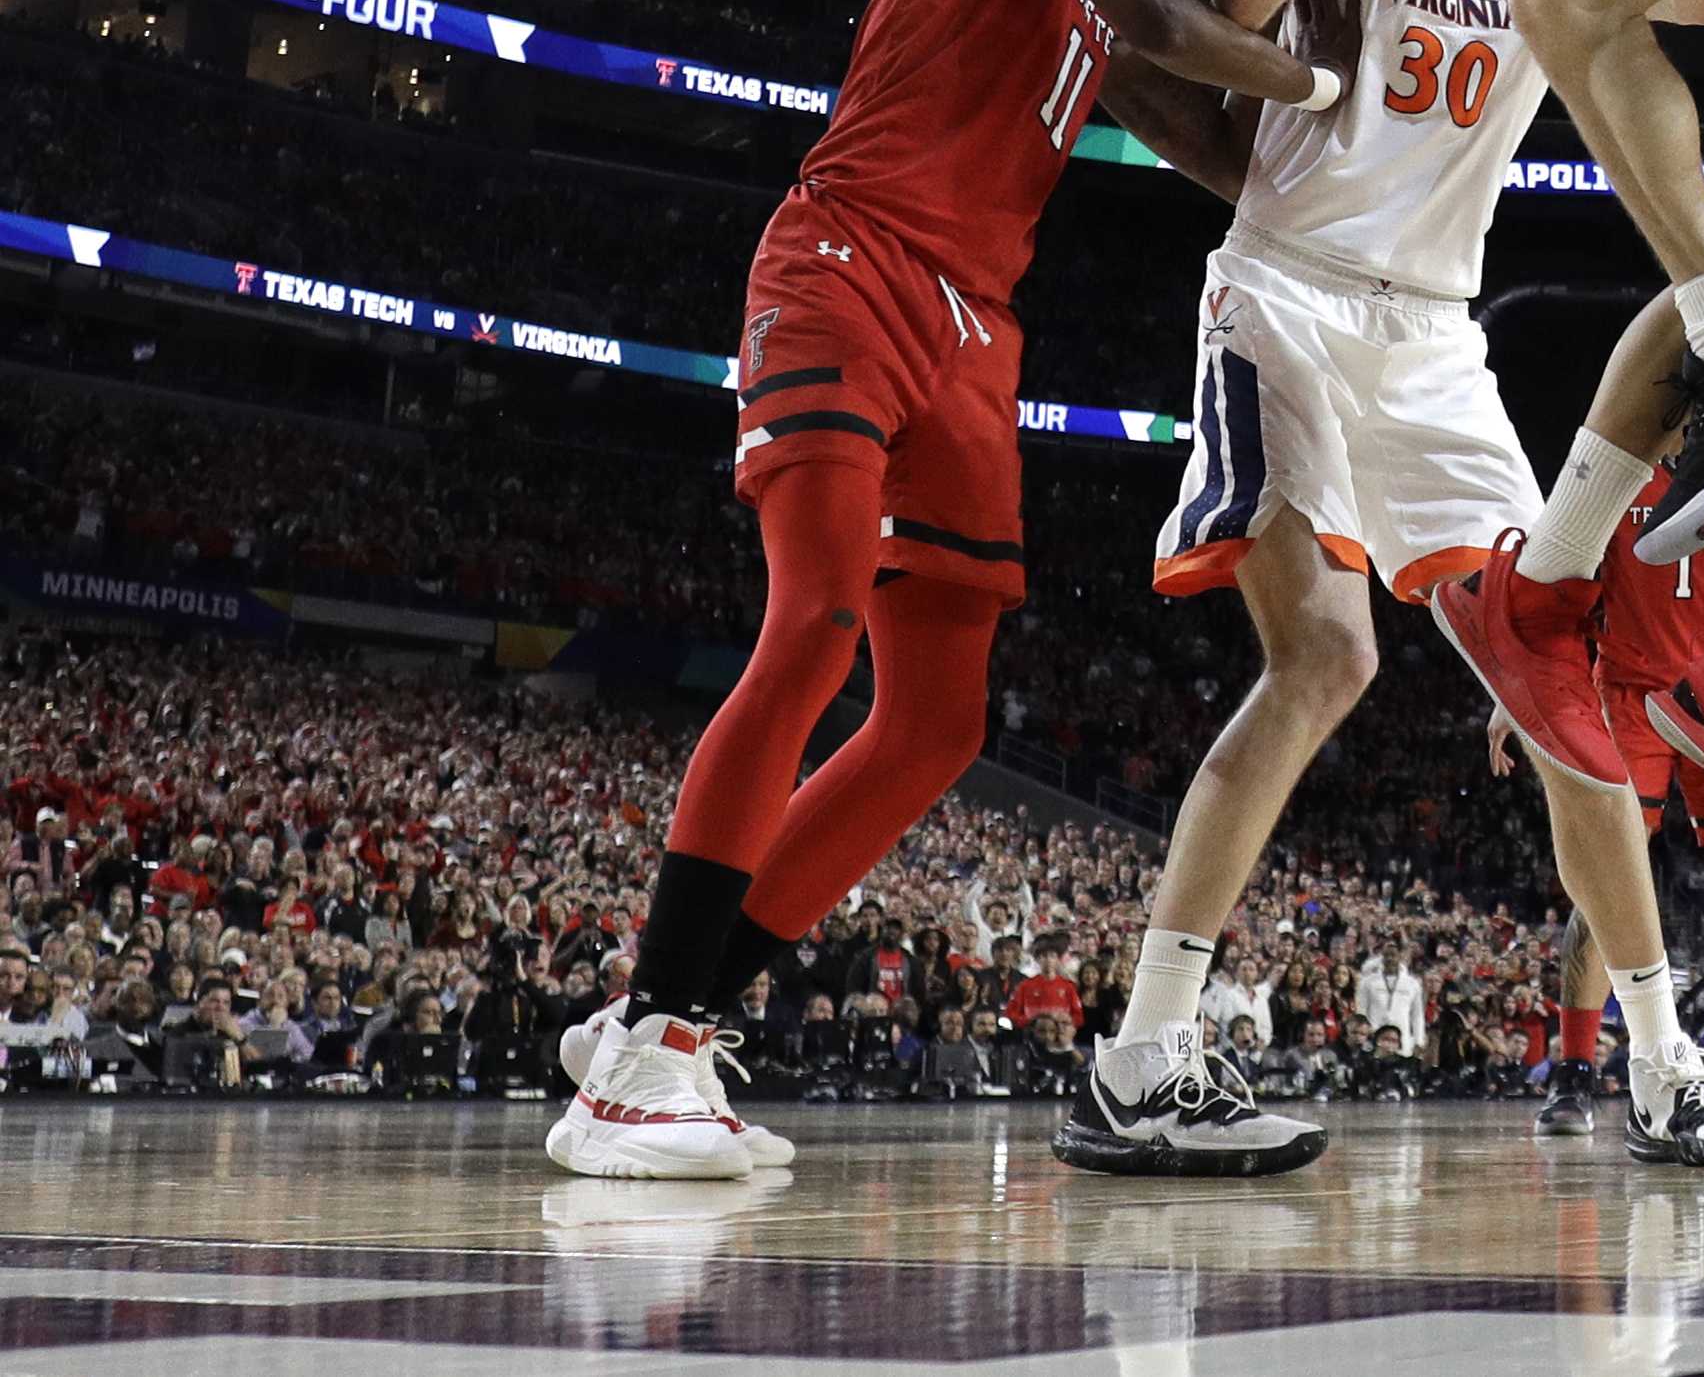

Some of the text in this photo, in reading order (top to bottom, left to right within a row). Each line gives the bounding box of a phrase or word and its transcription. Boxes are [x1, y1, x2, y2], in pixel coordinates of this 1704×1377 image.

[682, 65, 762, 102] TEXAS
[766, 81, 829, 114] TECH
[1040, 27, 1094, 150] 11
[1384, 25, 1499, 128] 30
[263, 270, 346, 312] TEXAS
[350, 287, 415, 326] TECH
[512, 322, 622, 365] VIRGINIA
[41, 570, 240, 621] MINNEAPOLIS
